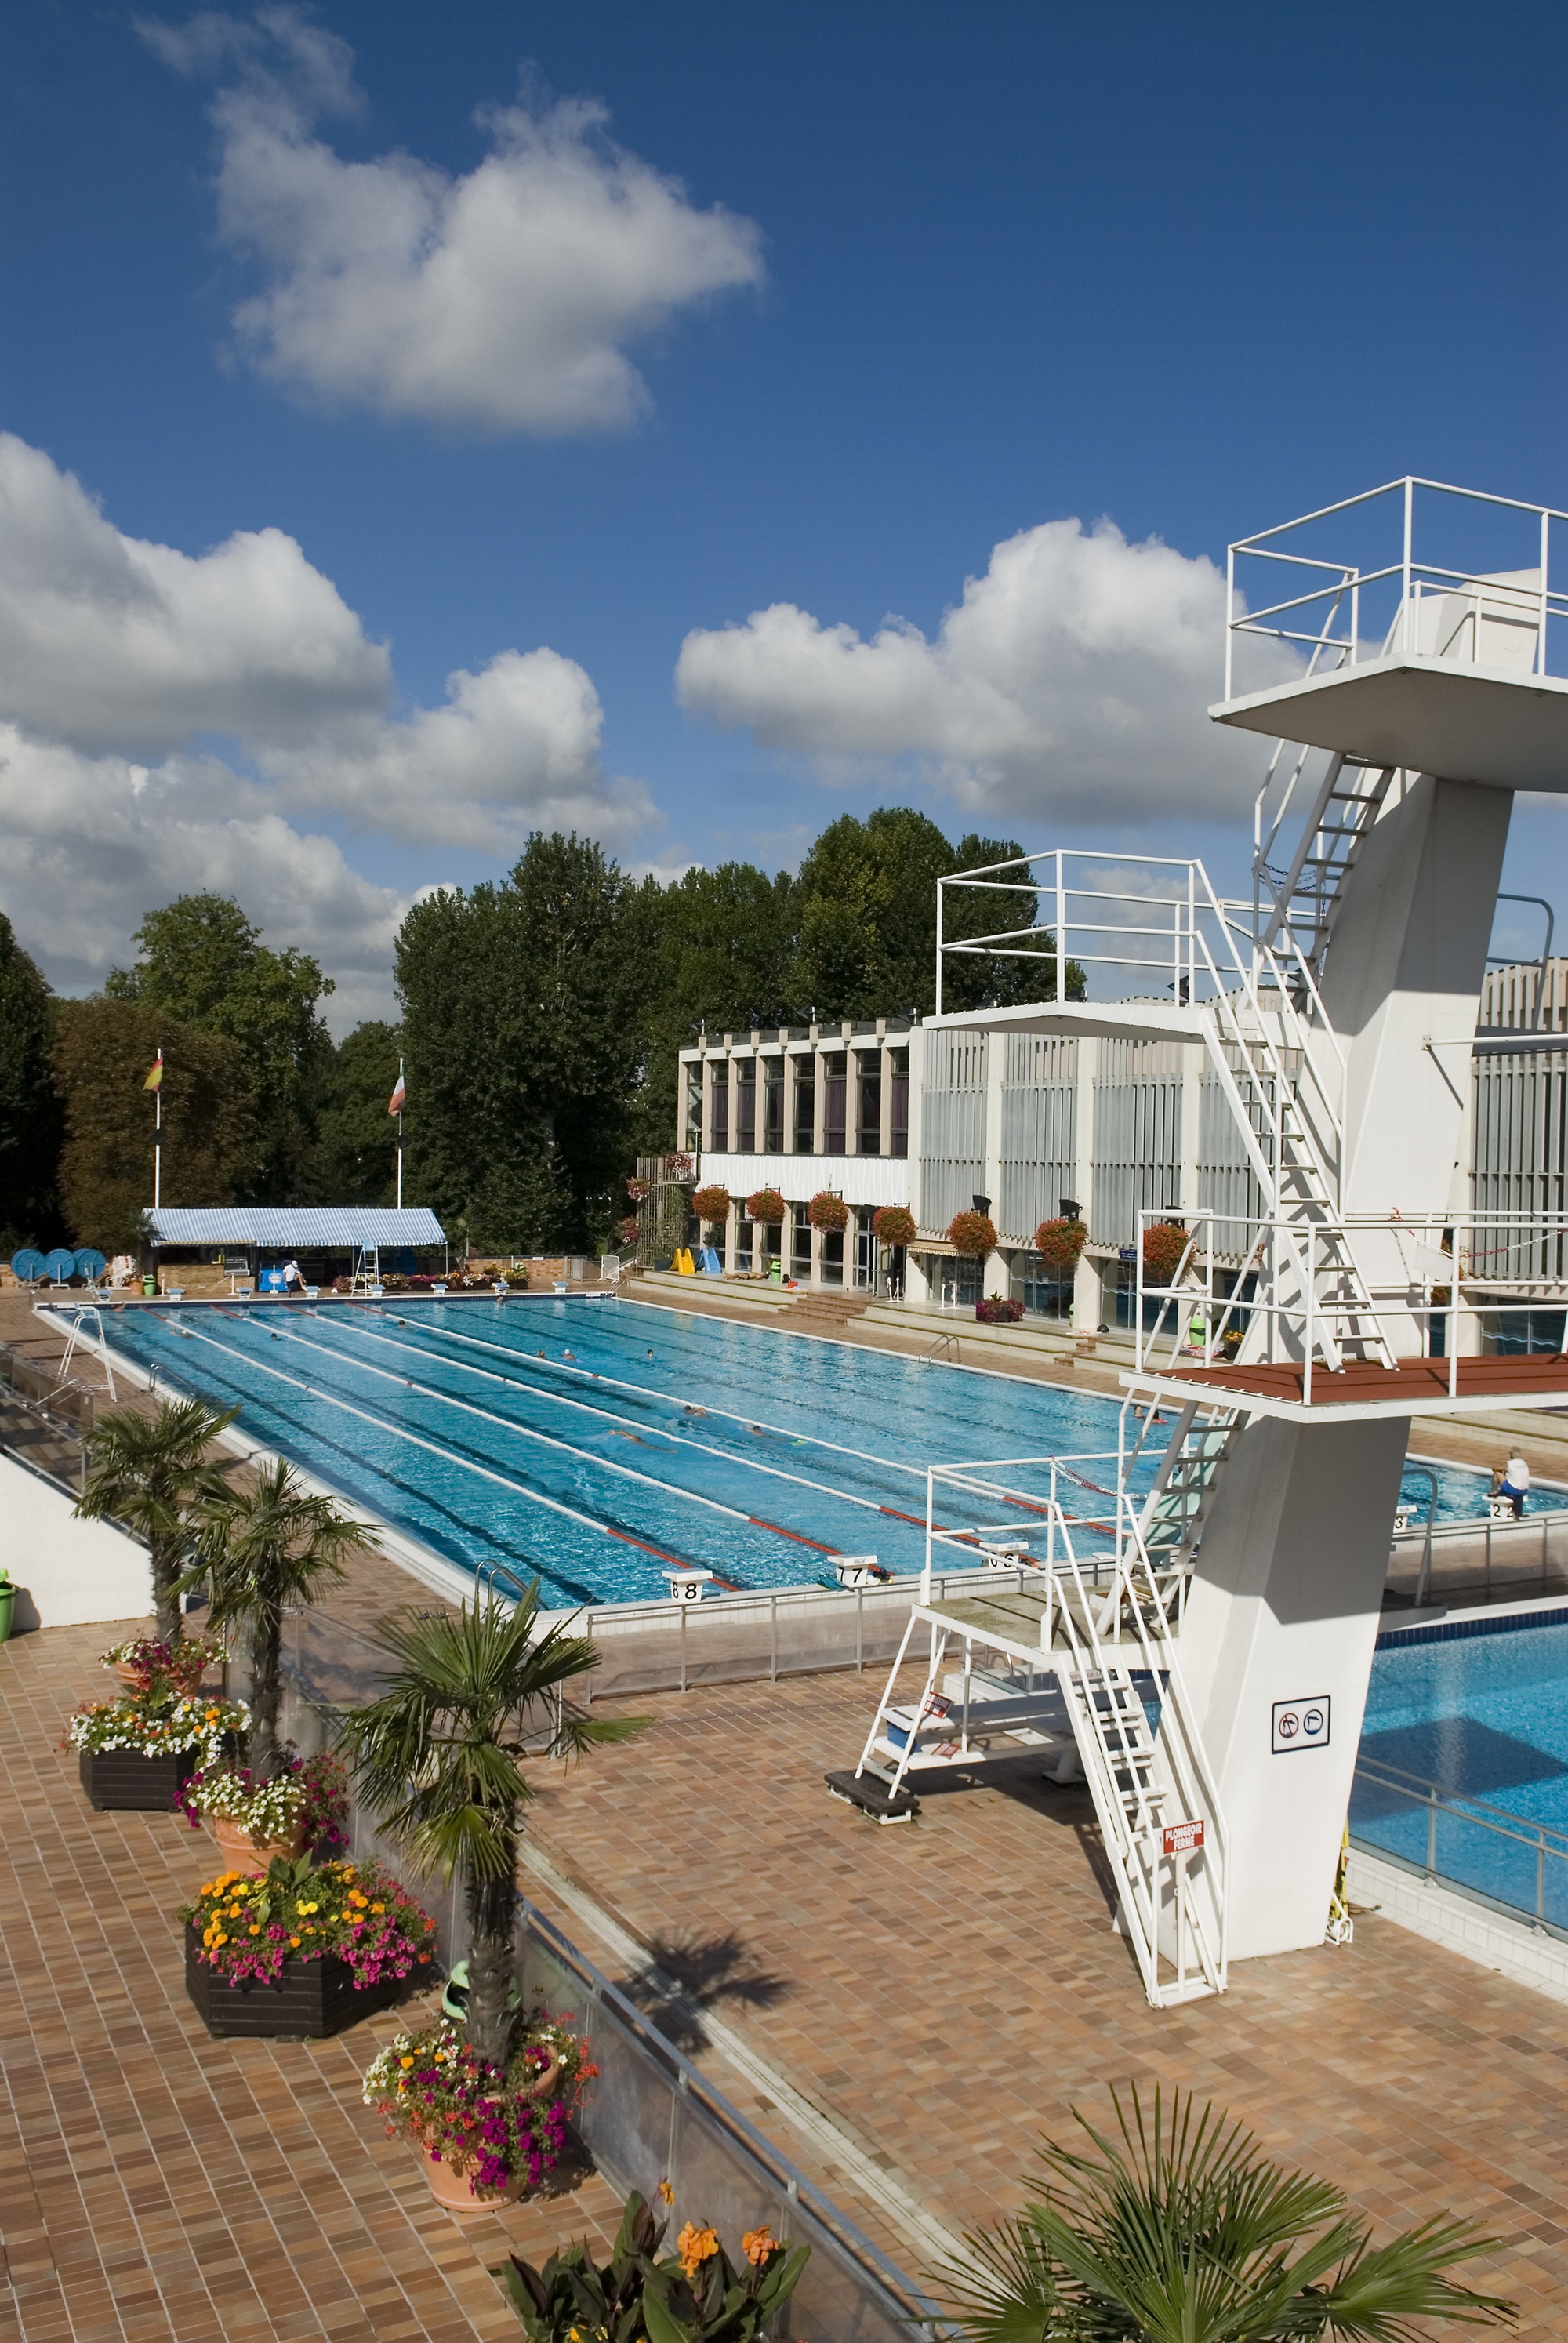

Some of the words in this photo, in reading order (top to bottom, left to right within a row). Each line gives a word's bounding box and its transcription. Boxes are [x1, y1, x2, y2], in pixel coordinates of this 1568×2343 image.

[1494, 1504, 1501, 1517] 2
[1395, 1516, 1403, 1529] 3
[852, 1567, 863, 1584] 7
[684, 1582, 697, 1600] 8
[1165, 1822, 1203, 1842] PLONGEOIR
[1174, 1836, 1196, 1851] FERME
